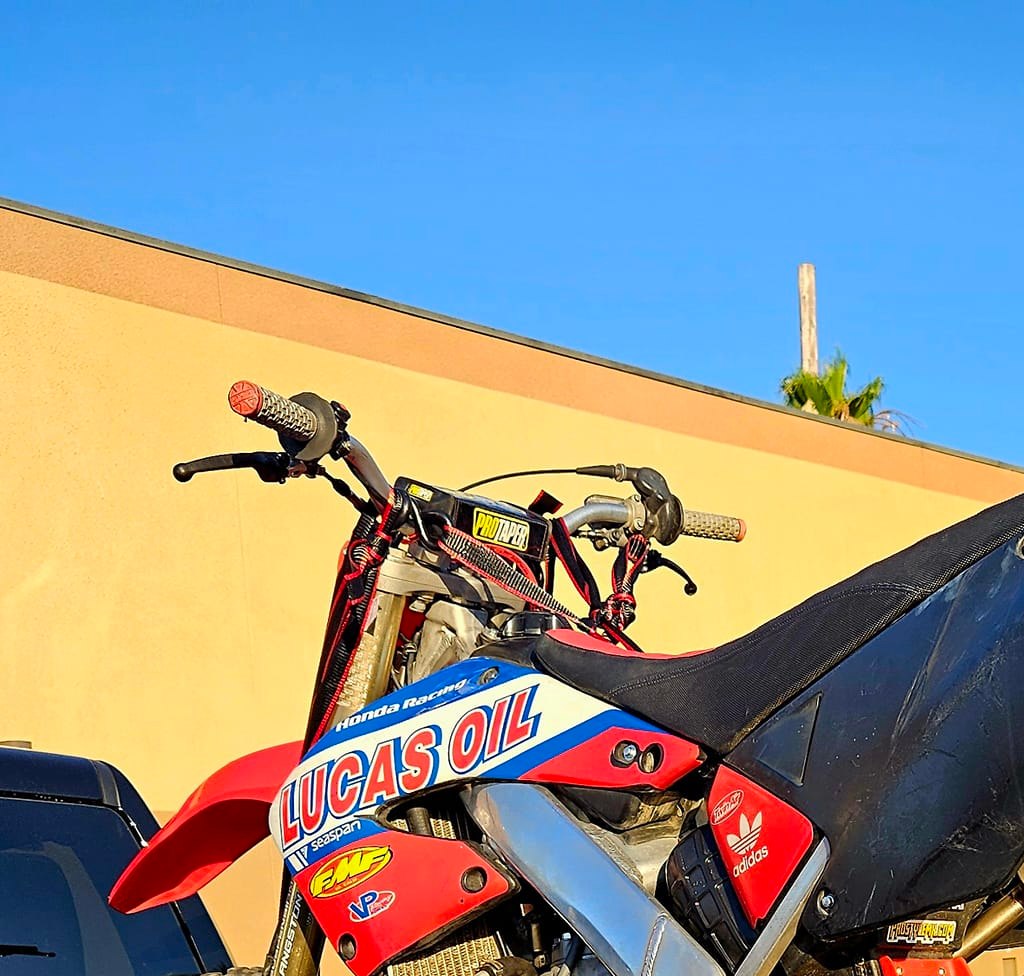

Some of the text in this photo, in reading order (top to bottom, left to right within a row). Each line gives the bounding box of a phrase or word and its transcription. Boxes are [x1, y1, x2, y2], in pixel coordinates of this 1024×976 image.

[335, 678, 467, 732] Honda Racing
[280, 684, 541, 851] LUCAS OIL
[311, 820, 361, 852] seaspan
[312, 845, 390, 897] FMF
[733, 846, 768, 877] adidas
[349, 890, 378, 920] VP
